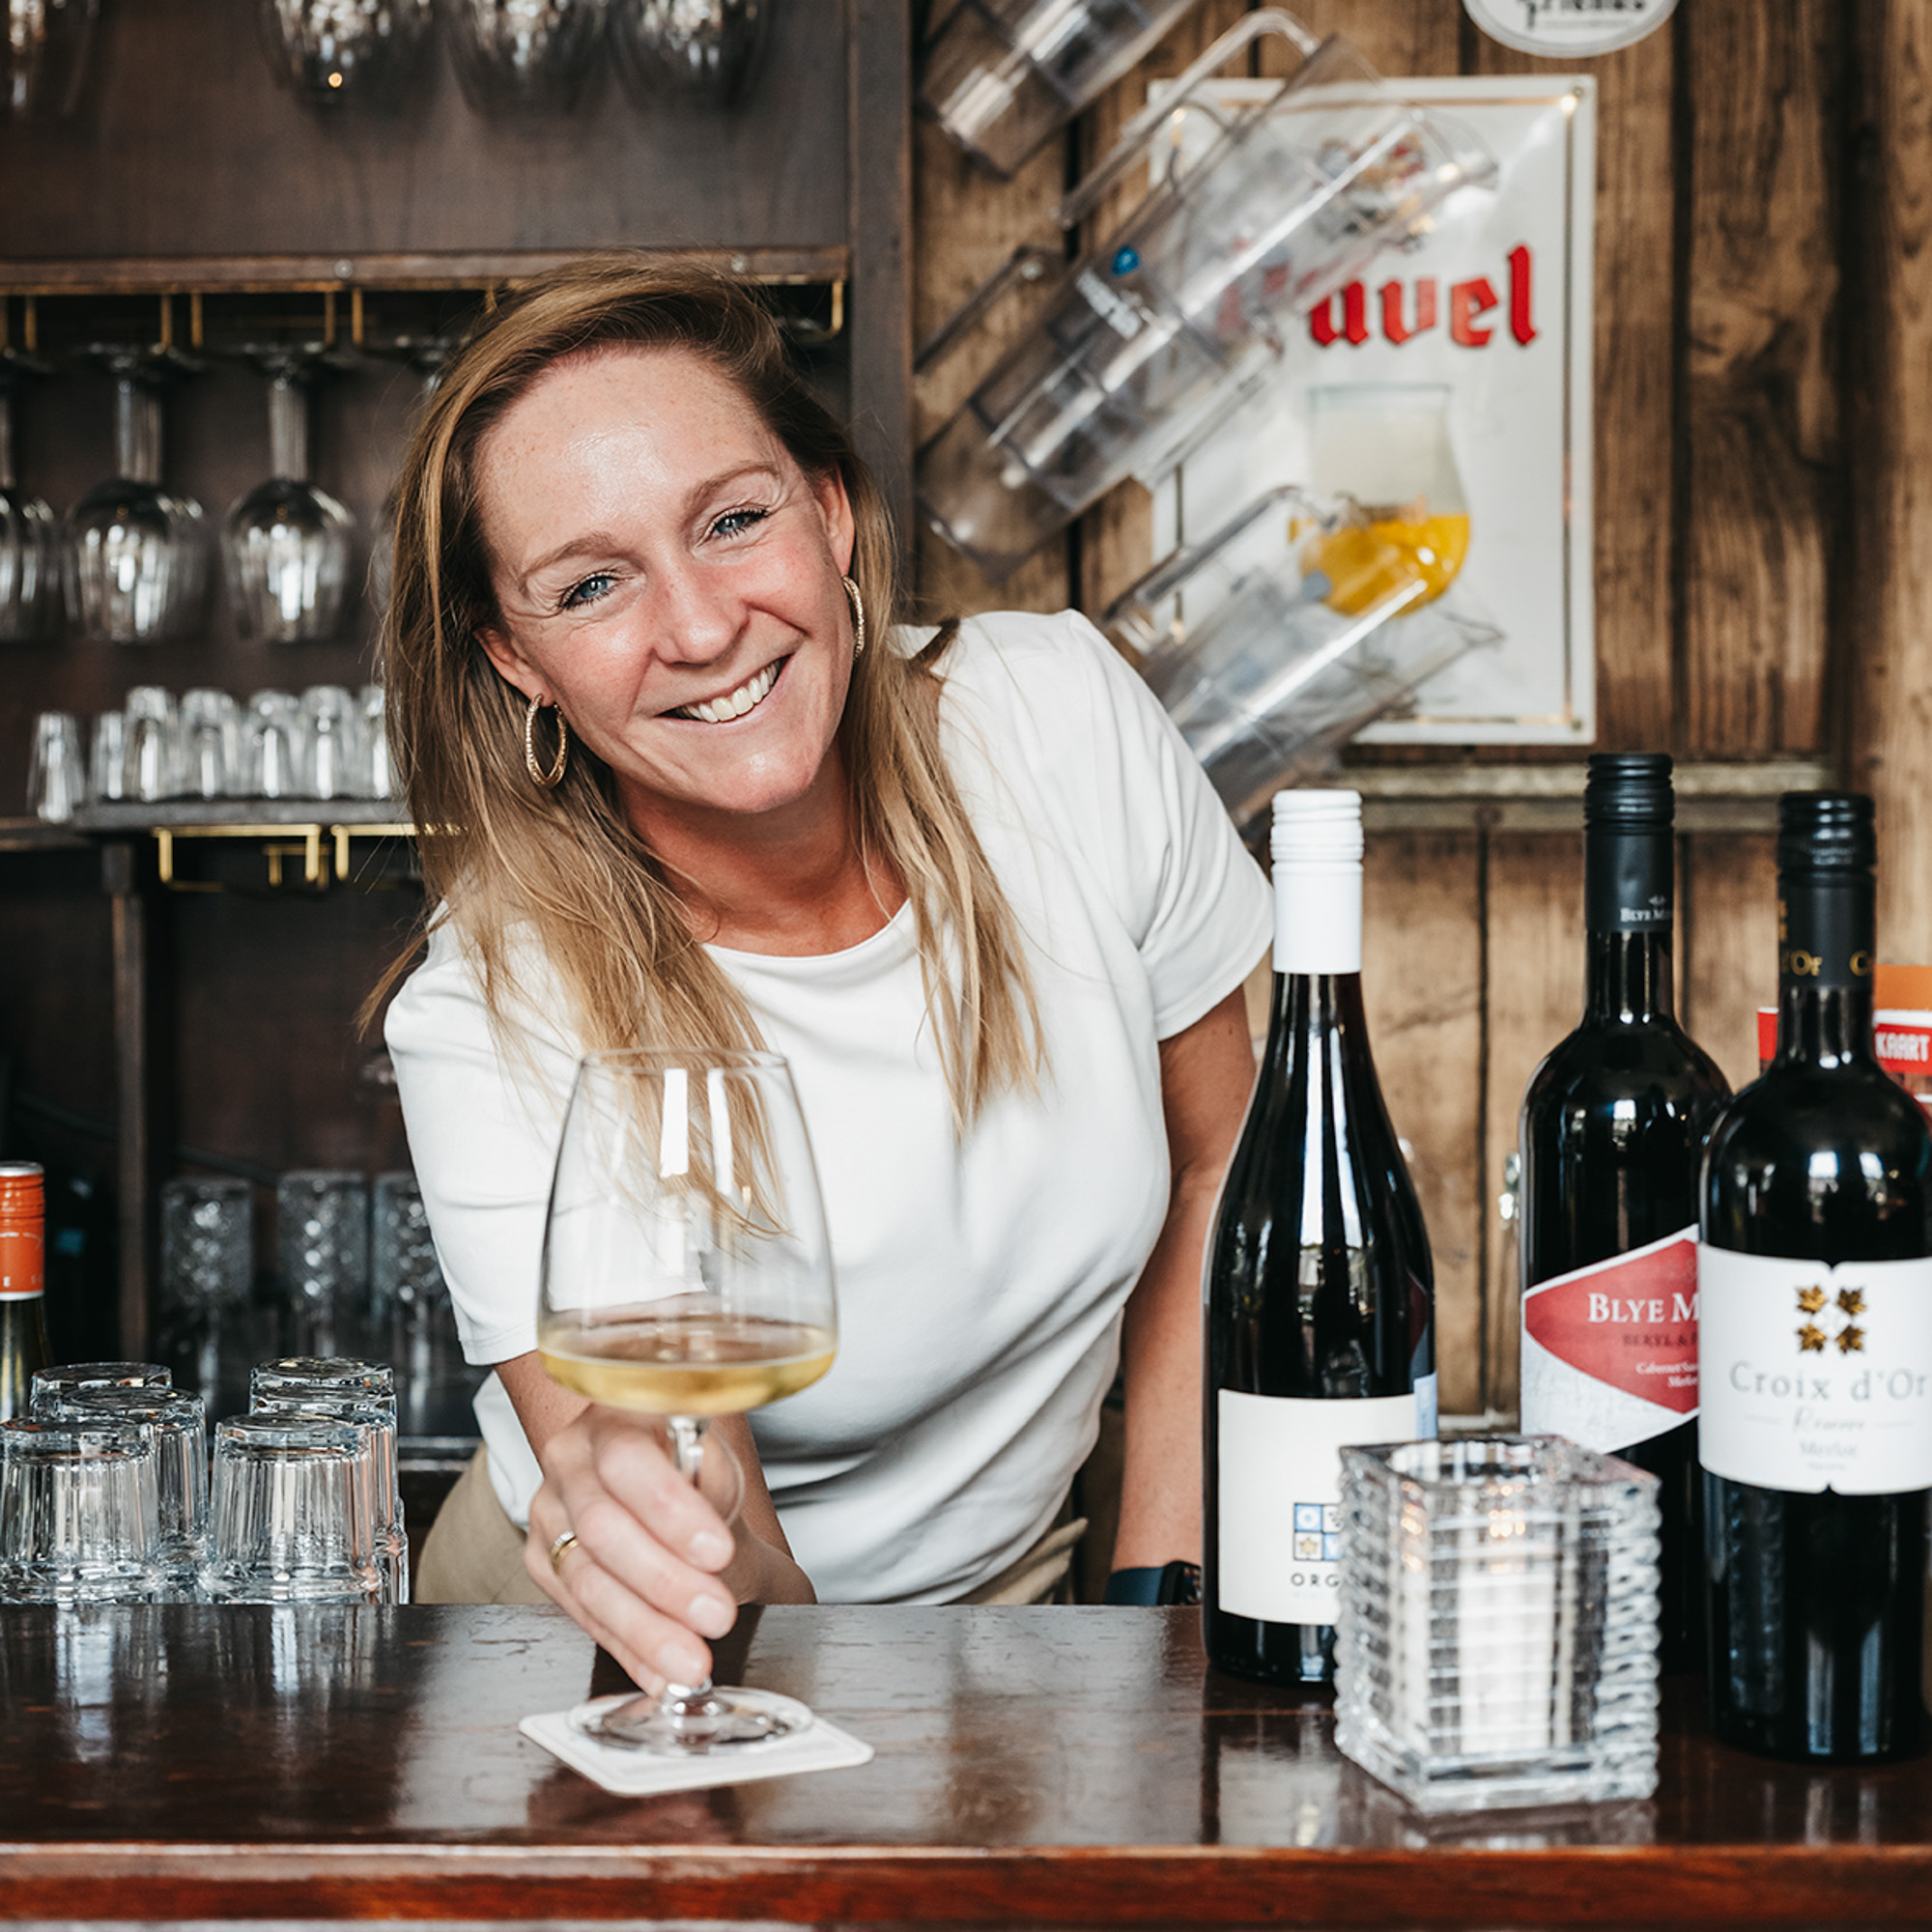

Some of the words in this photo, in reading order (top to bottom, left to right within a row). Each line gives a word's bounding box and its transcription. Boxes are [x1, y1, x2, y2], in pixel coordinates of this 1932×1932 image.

[1306, 244, 1538, 348] uvel
[1875, 1032, 1931, 1063] KAART
[1587, 1292, 1665, 1324] BLYE
[1729, 1361, 1832, 1402] Croix
[1850, 1368, 1930, 1403] d'Or
